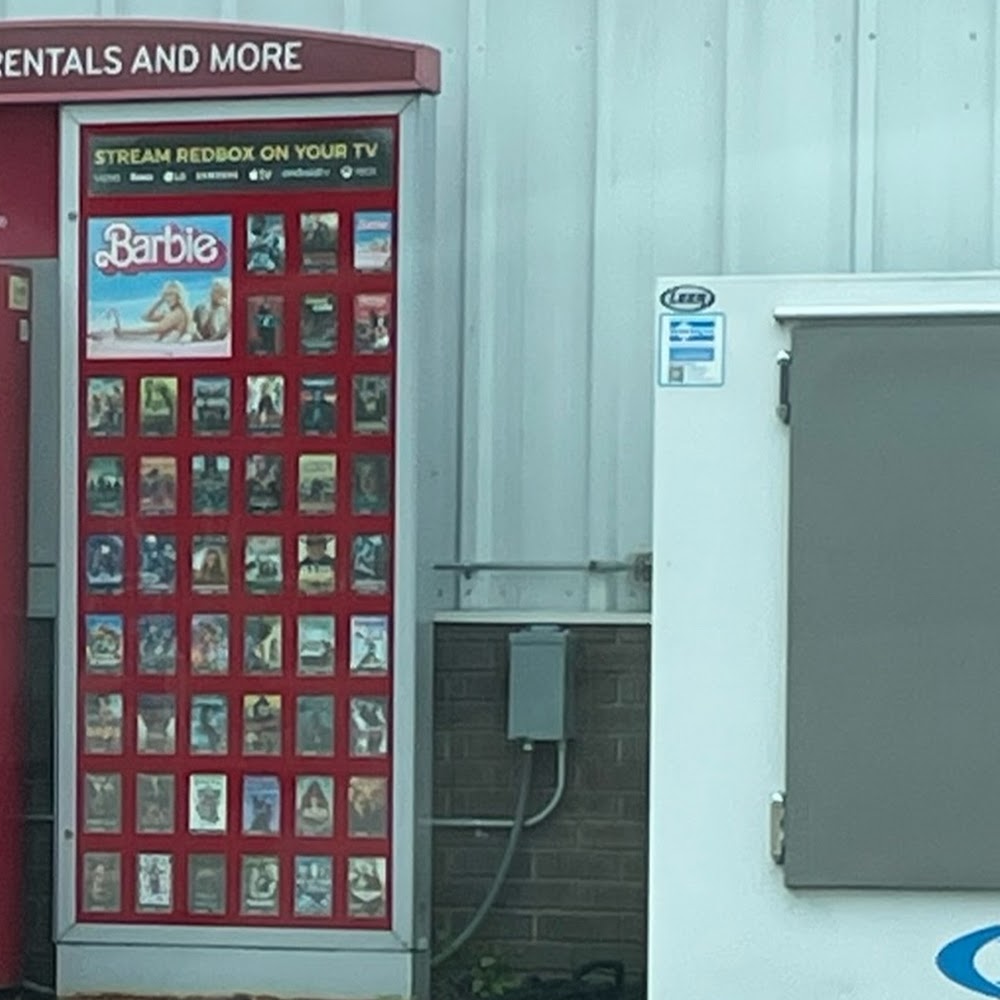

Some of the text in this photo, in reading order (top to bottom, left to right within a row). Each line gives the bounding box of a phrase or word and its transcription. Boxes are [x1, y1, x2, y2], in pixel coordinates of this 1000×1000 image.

[130, 44, 200, 75] AND
[209, 41, 302, 73] MORE
[94, 142, 378, 165] STREAM REDBOX ON YOUR TV
[95, 221, 220, 270] Barbie
